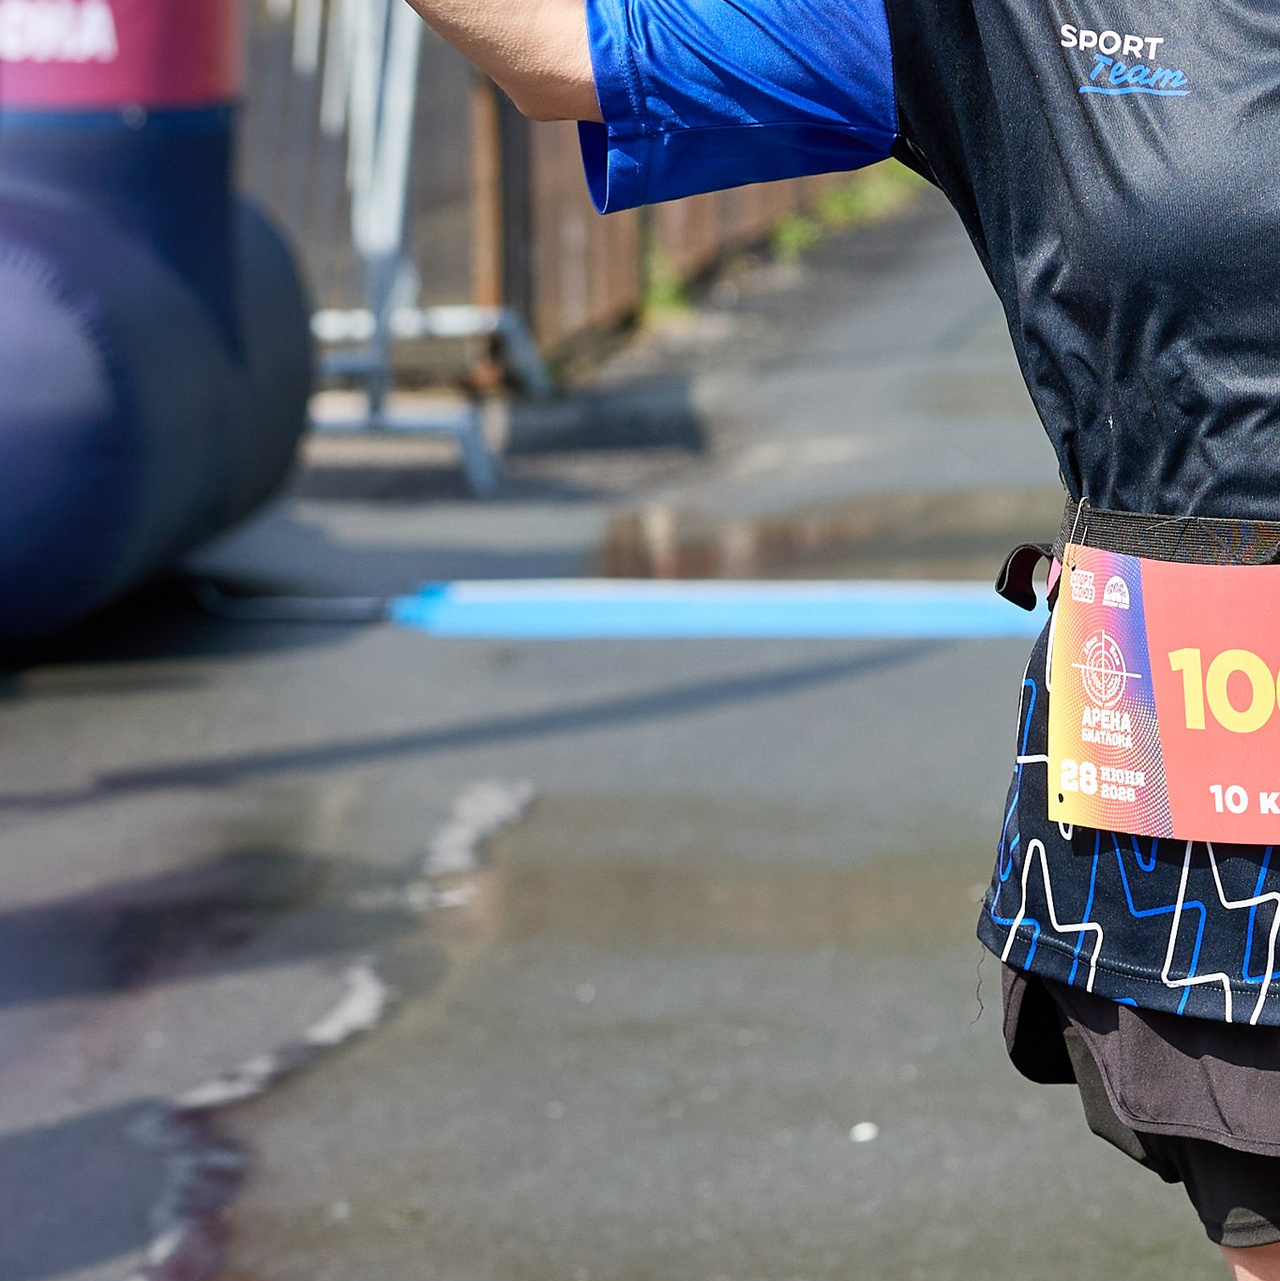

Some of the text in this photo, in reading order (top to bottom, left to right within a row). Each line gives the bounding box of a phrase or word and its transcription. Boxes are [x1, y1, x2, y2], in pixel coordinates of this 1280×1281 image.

[1060, 23, 1164, 60] SPORT
[1089, 53, 1188, 89] Team
[1081, 705, 1132, 733] АРЕНА
[1061, 758, 1098, 795] 28
[1209, 784, 1249, 814] 10
